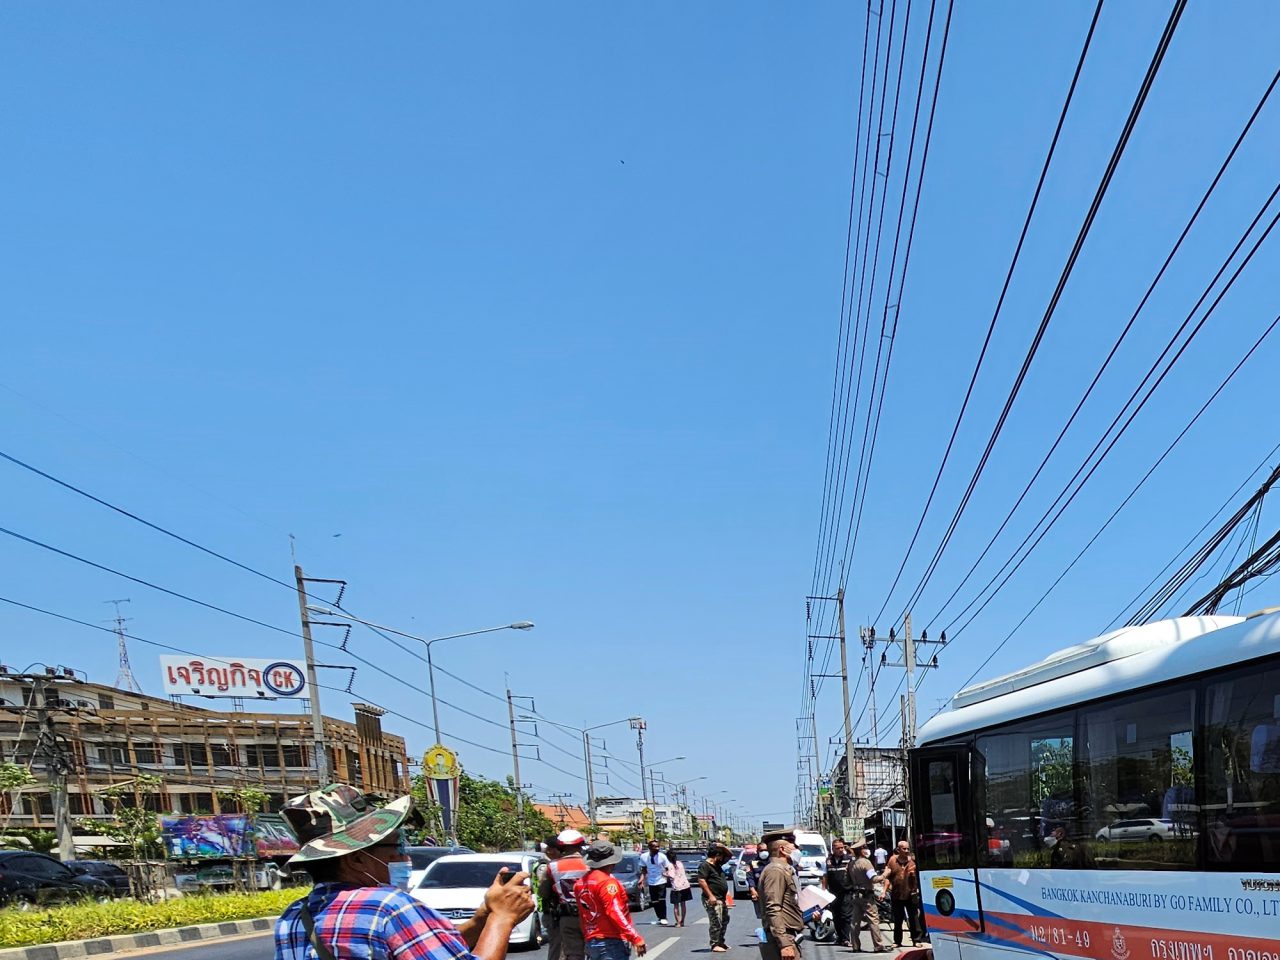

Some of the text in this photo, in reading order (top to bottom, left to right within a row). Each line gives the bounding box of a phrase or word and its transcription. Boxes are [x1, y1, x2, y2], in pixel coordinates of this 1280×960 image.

[167, 660, 295, 692] เจริญกิจ CK
[1041, 887, 1079, 902] BANGKOK
[1080, 890, 1152, 908] KANCHANABURI
[1154, 894, 1168, 909] BY
[1170, 894, 1186, 910] GO
[1188, 896, 1232, 913] FAMILY
[1235, 897, 1260, 918] CO.,
